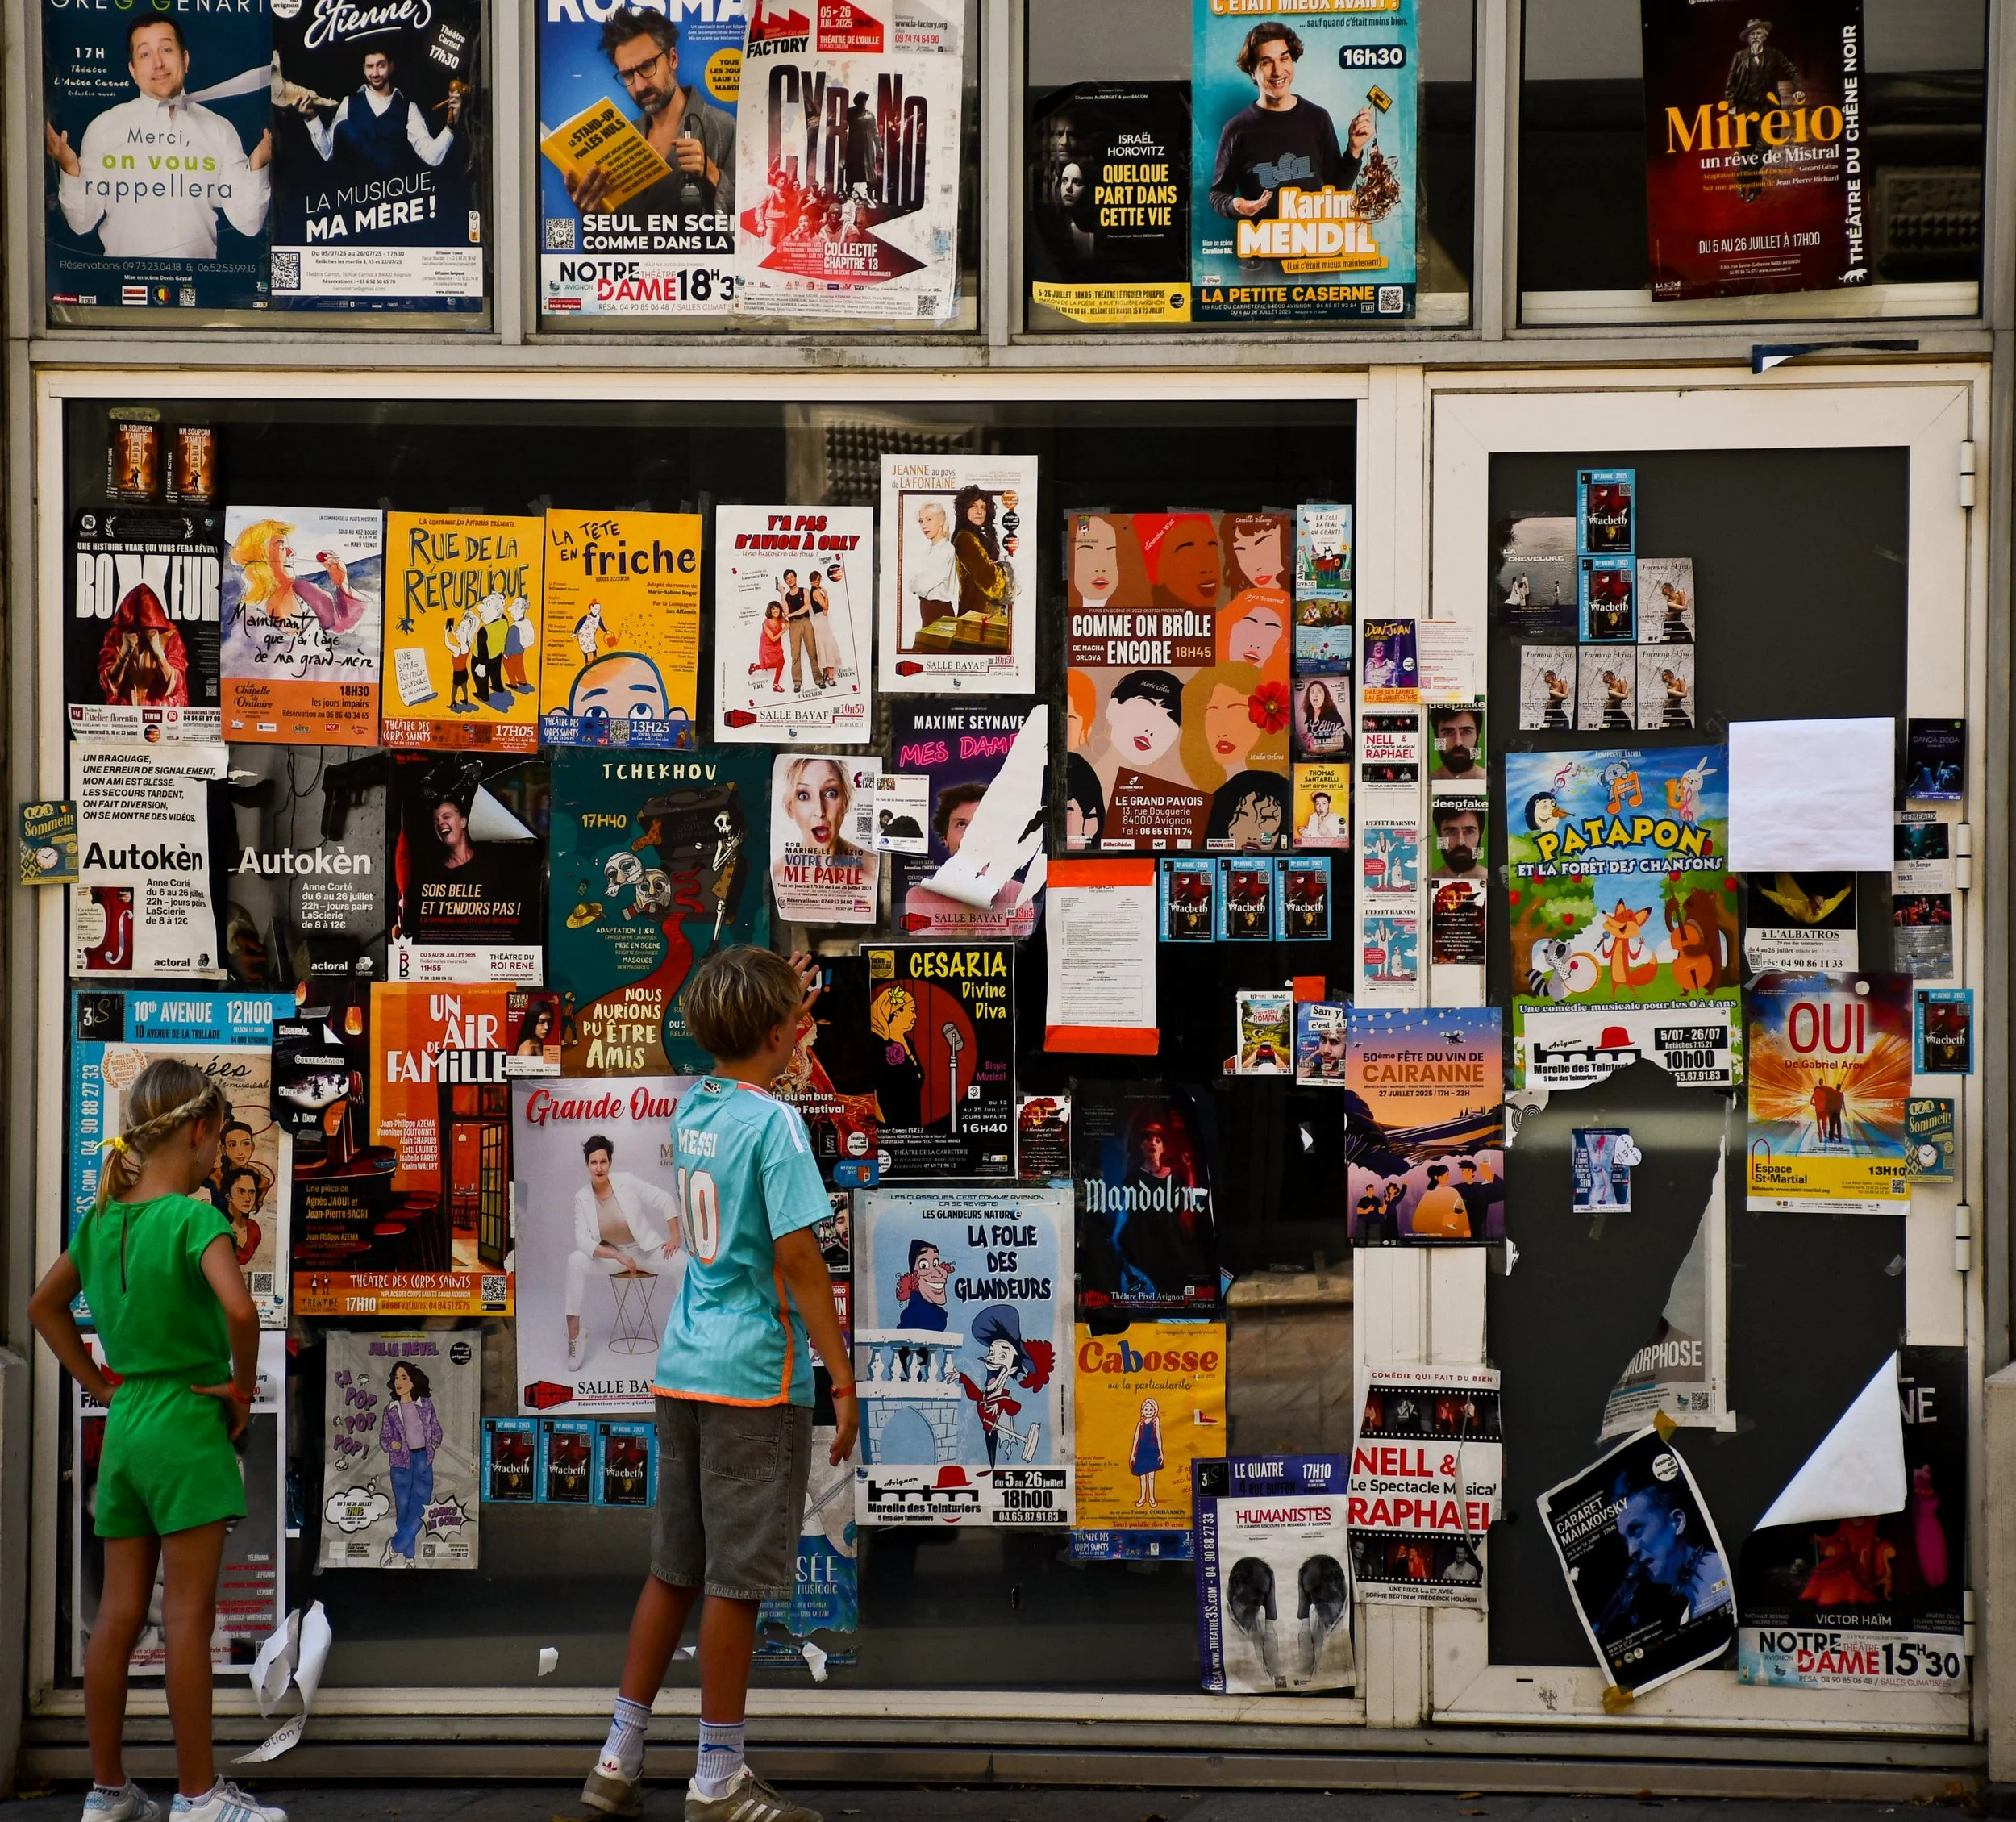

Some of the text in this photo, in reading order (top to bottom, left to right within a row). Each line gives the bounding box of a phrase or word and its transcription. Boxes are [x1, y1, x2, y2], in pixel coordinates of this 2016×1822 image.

[76, 47, 105, 59] 17H
[429, 44, 460, 69] 17h30
[748, 37, 808, 59] FACTORY
[1344, 48, 1402, 65] 16h30
[127, 128, 190, 147] Merci,
[768, 65, 927, 212] CYRNO
[1118, 132, 1153, 144] ISRAËL
[1843, 24, 1863, 264] THÉÂTRE DU CHÊNE NOIR
[1108, 146, 1164, 156] HOROVITZ
[1701, 144, 1839, 169] un rêve de Mistral
[102, 155, 216, 171] on vous
[1103, 164, 1168, 186] QUELQUE
[85, 174, 232, 203] rappellera
[306, 171, 435, 214] LA MUSIQUE,
[1095, 185, 1177, 204] PART DANS
[1282, 190, 1352, 219] Karim
[1100, 208, 1171, 227] CETTE VIE
[1241, 223, 1374, 254] MENDIL
[824, 243, 877, 257] COLLECTIF
[560, 262, 639, 282] NOTRE
[824, 257, 878, 269] CHAPITRE 13
[598, 279, 675, 300] DAME
[1202, 286, 1374, 302] LA PETITE CASERNE
[892, 465, 929, 477] JEANNE
[940, 469, 956, 477] pays
[900, 477, 910, 489] LA
[912, 477, 956, 489] FONTAINE
[768, 515, 827, 531] Y'A PAS
[552, 520, 620, 546] LA TÊTE
[735, 532, 860, 551] D'AVION À ORLY
[410, 527, 517, 565] RUE DE LA
[561, 540, 696, 576] EN friche
[403, 563, 529, 620] RÉPUBLIQUE
[230, 602, 317, 636] Maintenant
[1073, 610, 1211, 637] COMME ON BRÛLE
[1107, 640, 1171, 664] ENCORE
[1175, 647, 1211, 658] 18H45
[339, 686, 369, 697] 18H30
[760, 710, 829, 720] SALLE BAYAF
[496, 726, 533, 736] 17H05
[632, 722, 669, 732] 13H25
[603, 763, 717, 780] TCHEKHOV
[147, 790, 184, 799] TARDENT,
[1116, 797, 1202, 805] LE GRAND PAVOIS
[1432, 799, 1489, 809] deepfake
[582, 814, 626, 828] 17H40
[1536, 814, 1712, 863] PATAPON
[83, 842, 202, 872] Autokèn
[238, 845, 371, 874] Autokèn
[1516, 857, 1722, 876] ET LA FORÊT DES CHANSONS
[785, 867, 864, 884] ME PARLE
[422, 884, 481, 897] SOIS BELLE
[146, 907, 185, 915] LaScierie
[1761, 929, 1839, 940] à L'ALBATROS
[154, 958, 190, 968] actoral
[910, 952, 1006, 978] CESARIA
[962, 982, 1006, 998] Divine
[160, 1002, 272, 1023] AVENUE 12H00
[430, 994, 460, 1021] UN
[976, 1003, 1006, 1019] Diva
[1789, 1003, 1864, 1054] OUI
[427, 1042, 439, 1053] DE
[1667, 1050, 1715, 1069] 10h00
[1785, 1060, 1799, 1068] De
[1802, 1059, 1838, 1069] Gabriel
[1363, 1065, 1484, 1082] CAIRANNE
[526, 1090, 626, 1126] Grande
[677, 1128, 717, 1157] MESSI
[1756, 1164, 1792, 1175] Espace
[1868, 1166, 1905, 1176] 13H10
[968, 1225, 1038, 1246] LA FOLIE
[987, 1253, 1018, 1273] DES
[955, 1278, 1052, 1302] GLANDEURS
[1156, 1292, 1184, 1302] Avignon
[346, 1297, 376, 1312] 17H10
[1079, 1340, 1218, 1374] Cabosse
[1235, 1462, 1331, 1479] LE QUATRE 17H10
[1353, 1447, 1432, 1478] NELL
[868, 1503, 902, 1512] Marelle
[904, 1503, 924, 1512] des
[1002, 1490, 1052, 1507] 18h00
[1236, 1507, 1331, 1524] HUMANISTES
[1556, 1498, 1603, 1533] CABARET
[1816, 1614, 1891, 1626] VICTOR HAÏM
[1760, 1632, 1841, 1653] NOTRE
[1797, 1649, 1880, 1674] DAME
